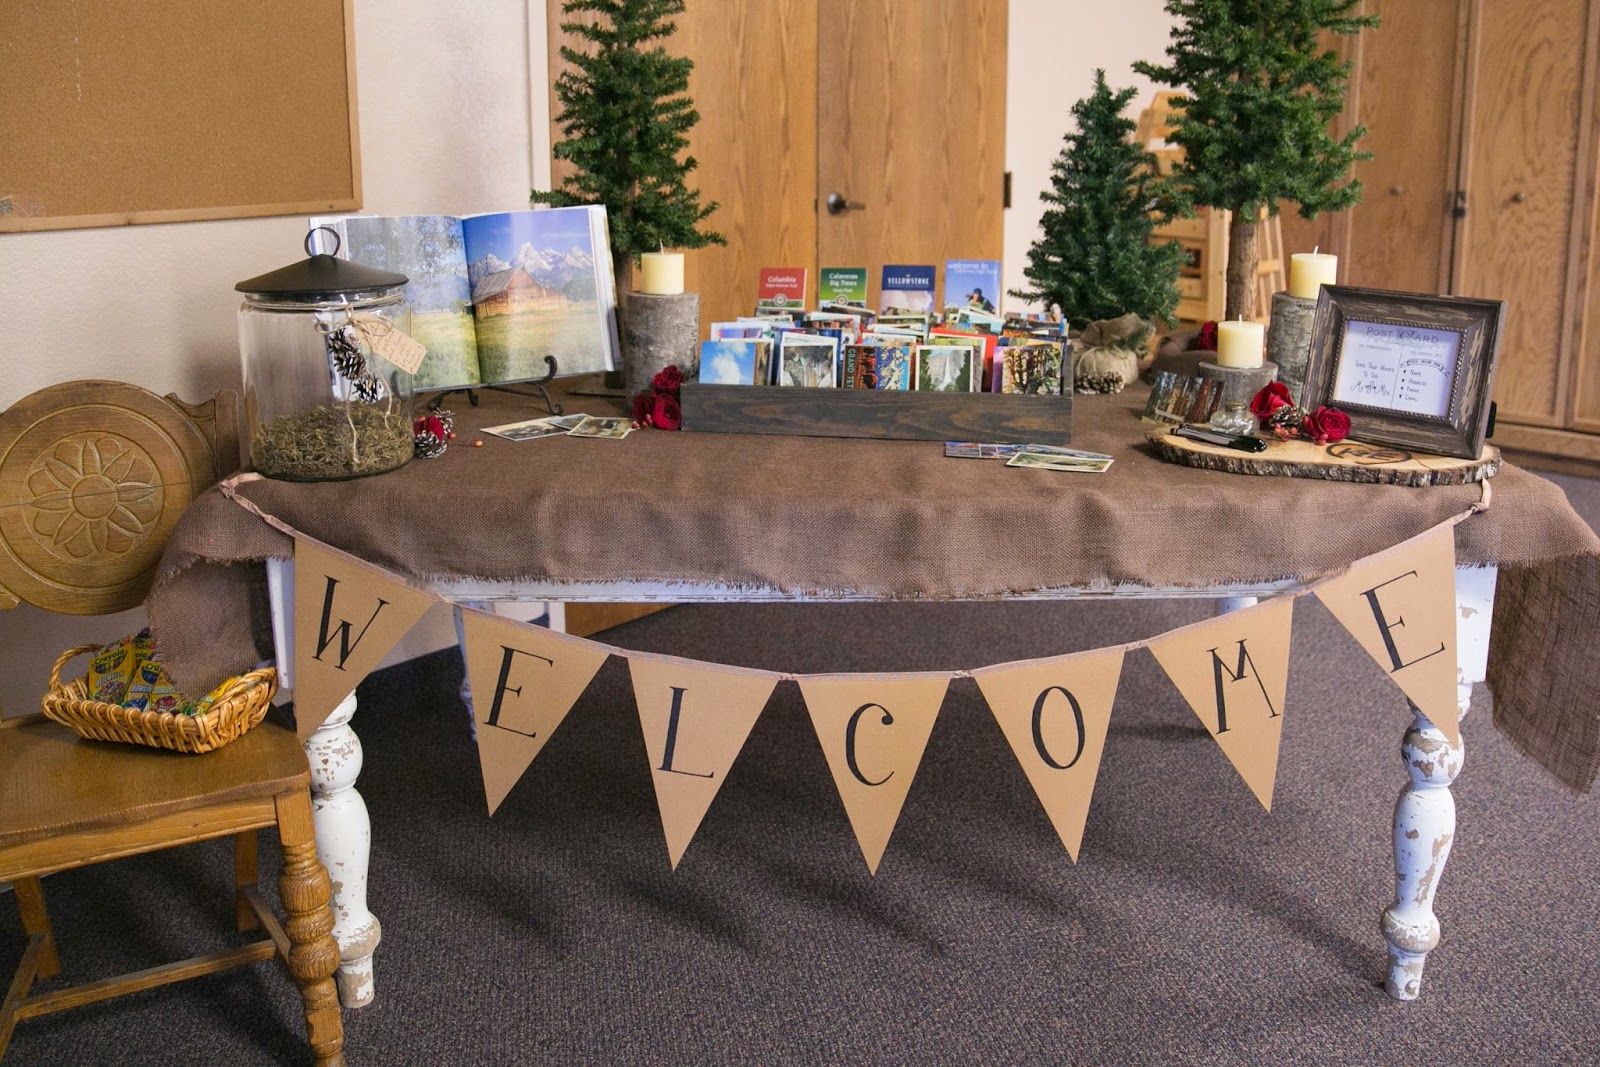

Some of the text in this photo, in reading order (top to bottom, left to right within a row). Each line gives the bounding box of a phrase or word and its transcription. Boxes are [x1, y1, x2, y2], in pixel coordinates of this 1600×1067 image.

[947, 263, 980, 271] welcome
[767, 275, 797, 283] Columbia
[829, 272, 858, 280] Calaveras
[829, 279, 857, 287] Big Trees
[887, 277, 930, 285] YELLOWSTONE
[1366, 326, 1394, 338] POST
[847, 348, 856, 373] GRAND
[94, 648, 126, 666] Crayola
[145, 662, 161, 673] Cra
[310, 569, 1447, 788] WELCOME
